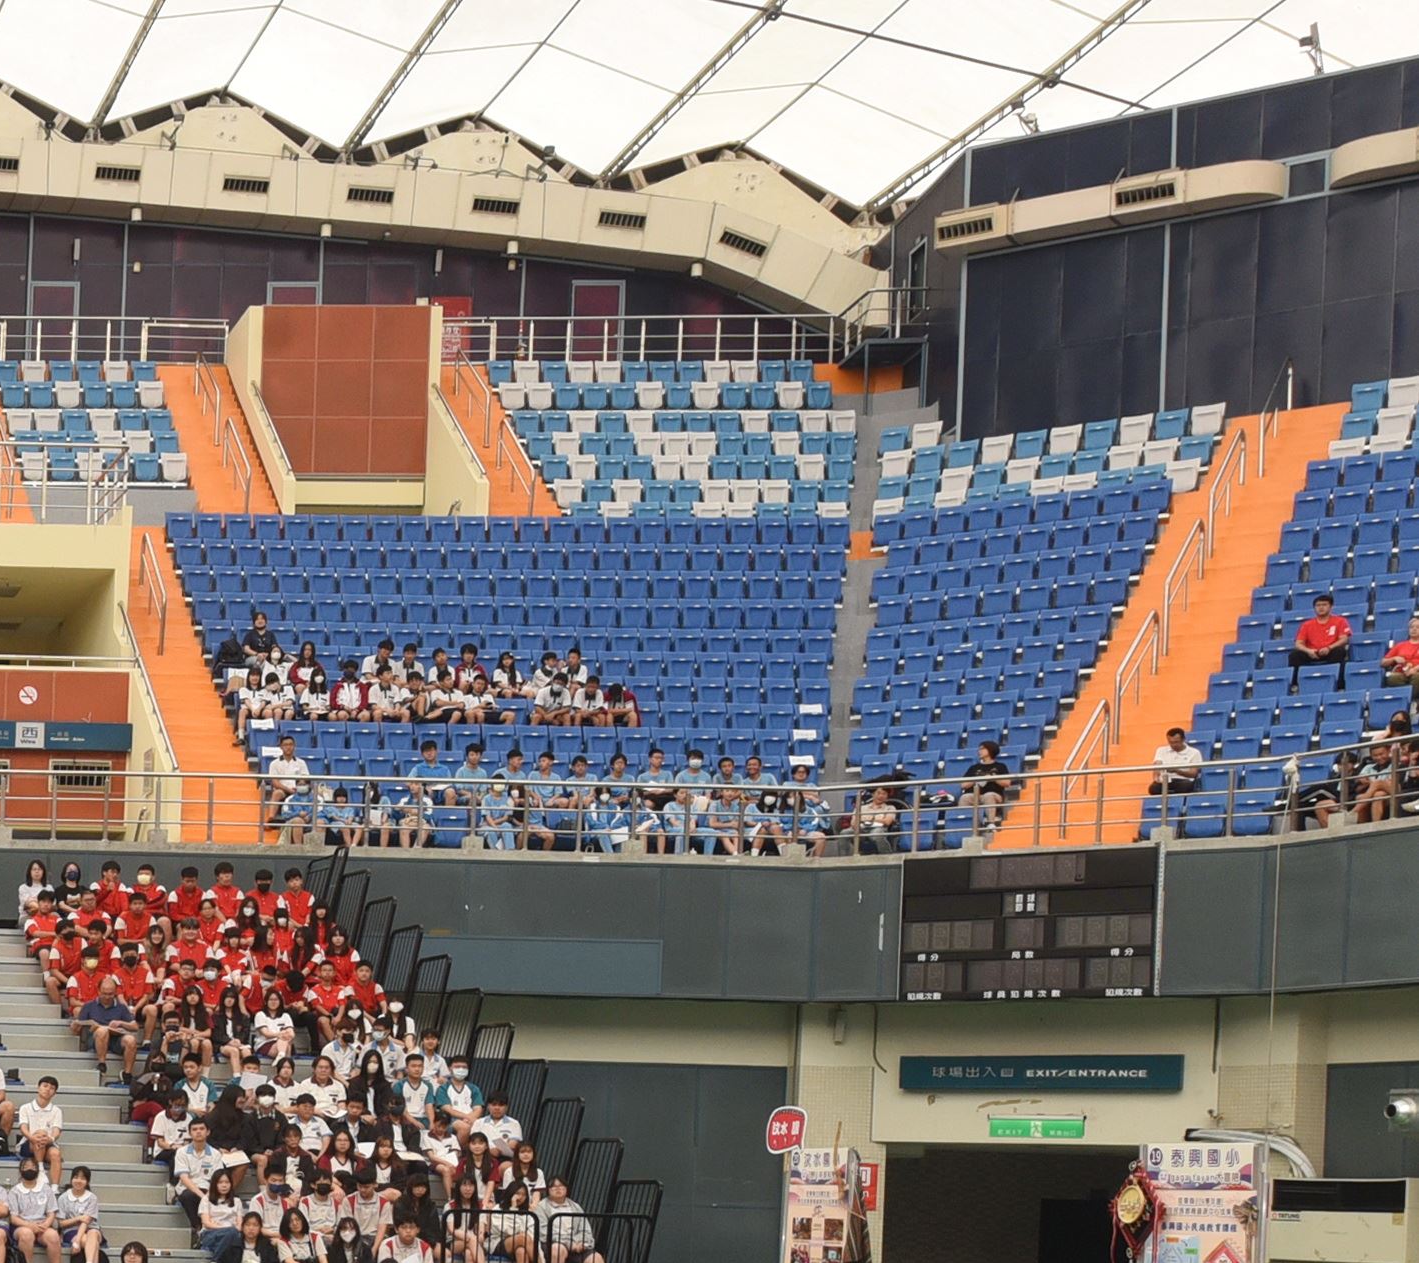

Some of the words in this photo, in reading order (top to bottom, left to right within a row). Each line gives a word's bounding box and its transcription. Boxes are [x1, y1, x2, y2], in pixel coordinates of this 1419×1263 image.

[932, 1066, 1014, 1079] 球場出入口
[1026, 1068, 1148, 1078] EXIT/ENTRANCE
[1151, 1148, 1162, 1163] 19
[1171, 1149, 1240, 1168] 泰興國小
